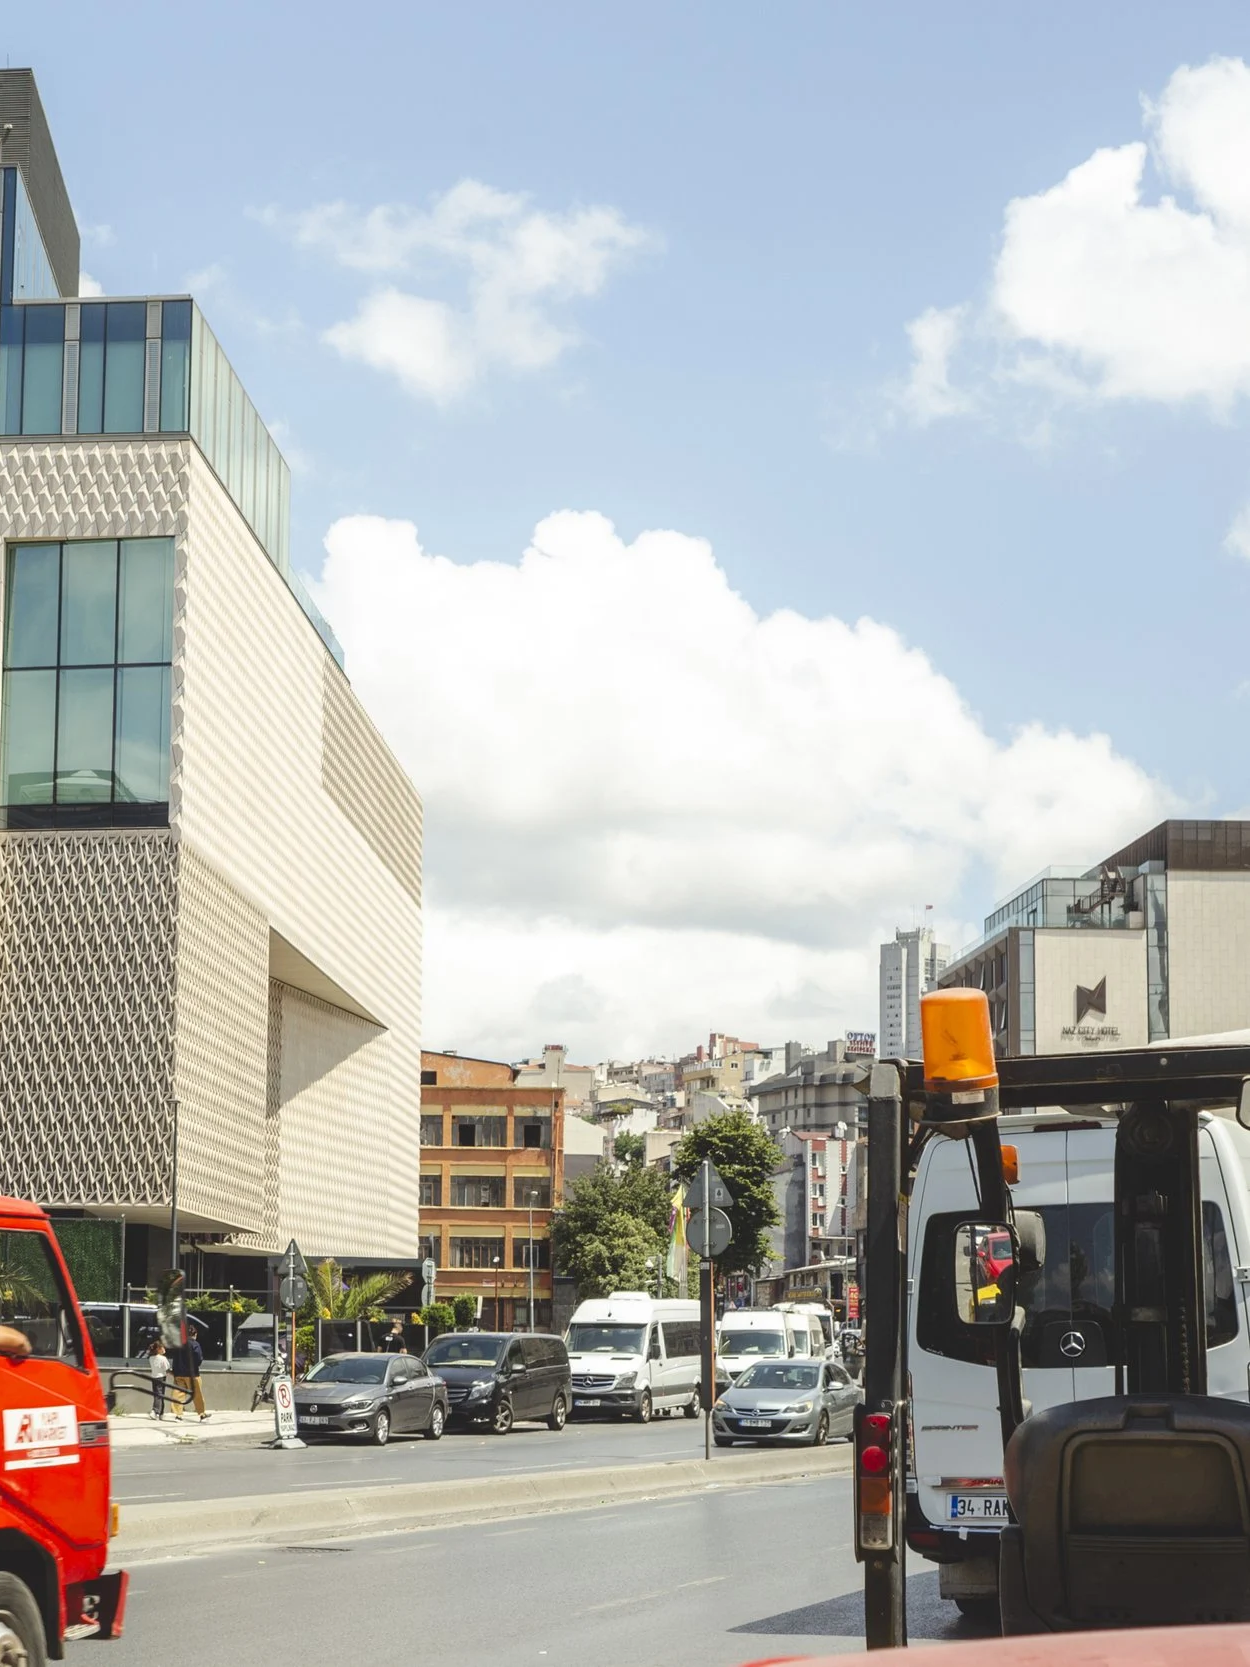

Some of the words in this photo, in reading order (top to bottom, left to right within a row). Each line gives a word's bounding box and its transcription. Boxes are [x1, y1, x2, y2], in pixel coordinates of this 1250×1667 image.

[1097, 1026, 1121, 1036] HOTEL
[280, 1412, 293, 1423] PARK
[958, 1499, 975, 1515] 34
